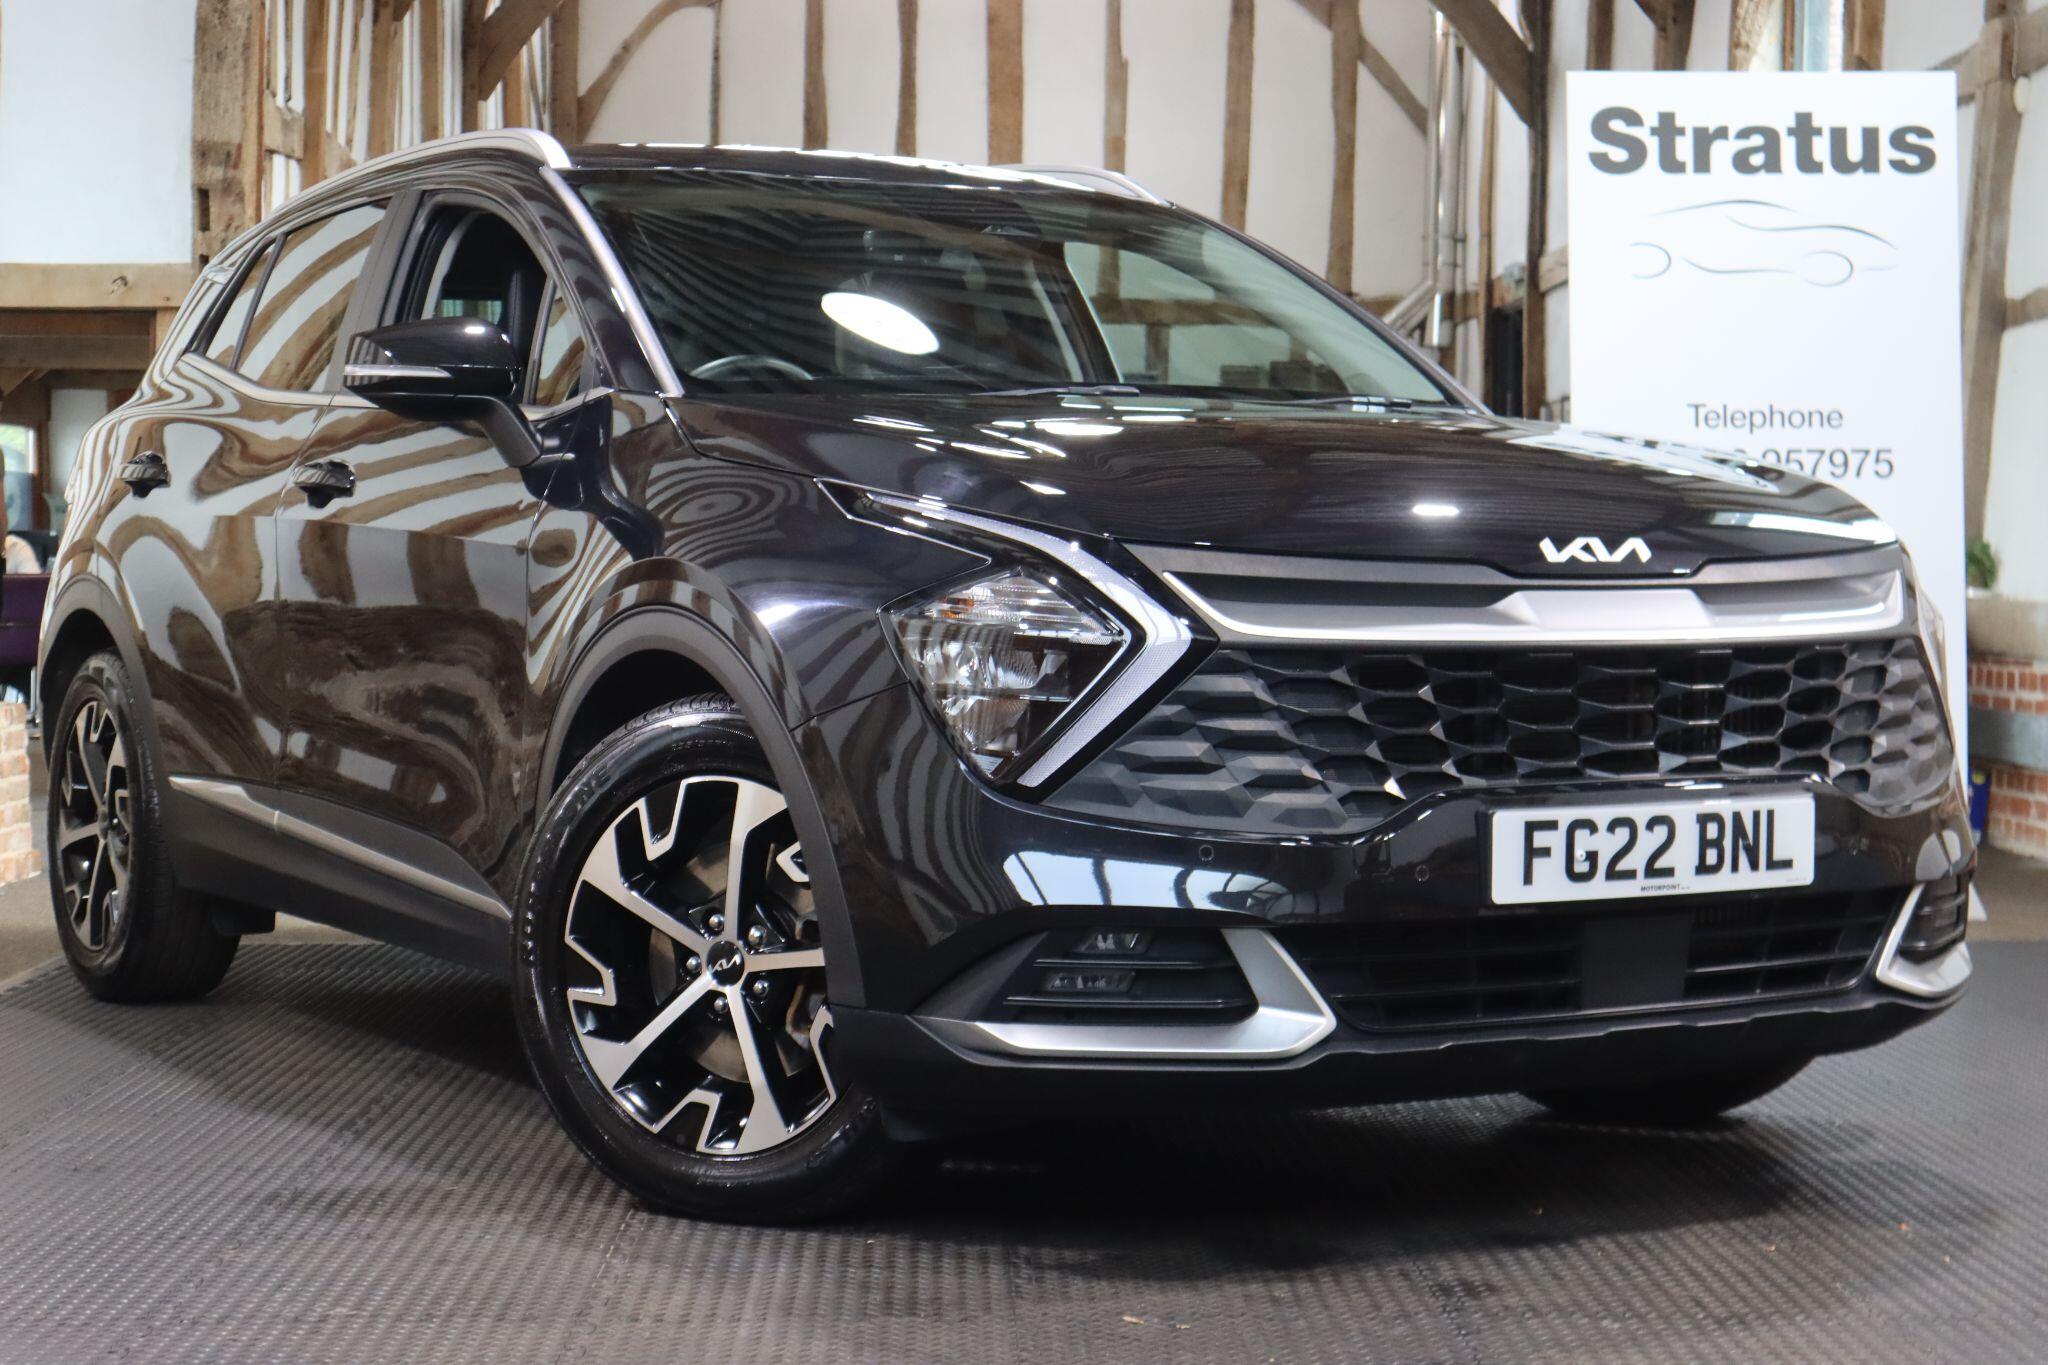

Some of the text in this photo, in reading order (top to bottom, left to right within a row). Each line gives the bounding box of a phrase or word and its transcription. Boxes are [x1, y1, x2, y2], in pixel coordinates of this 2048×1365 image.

[1588, 106, 1937, 175] Stratus
[1687, 403, 1844, 434] Telephone
[1538, 536, 1652, 563] KIA
[1523, 809, 1794, 886] FG22 BNL
